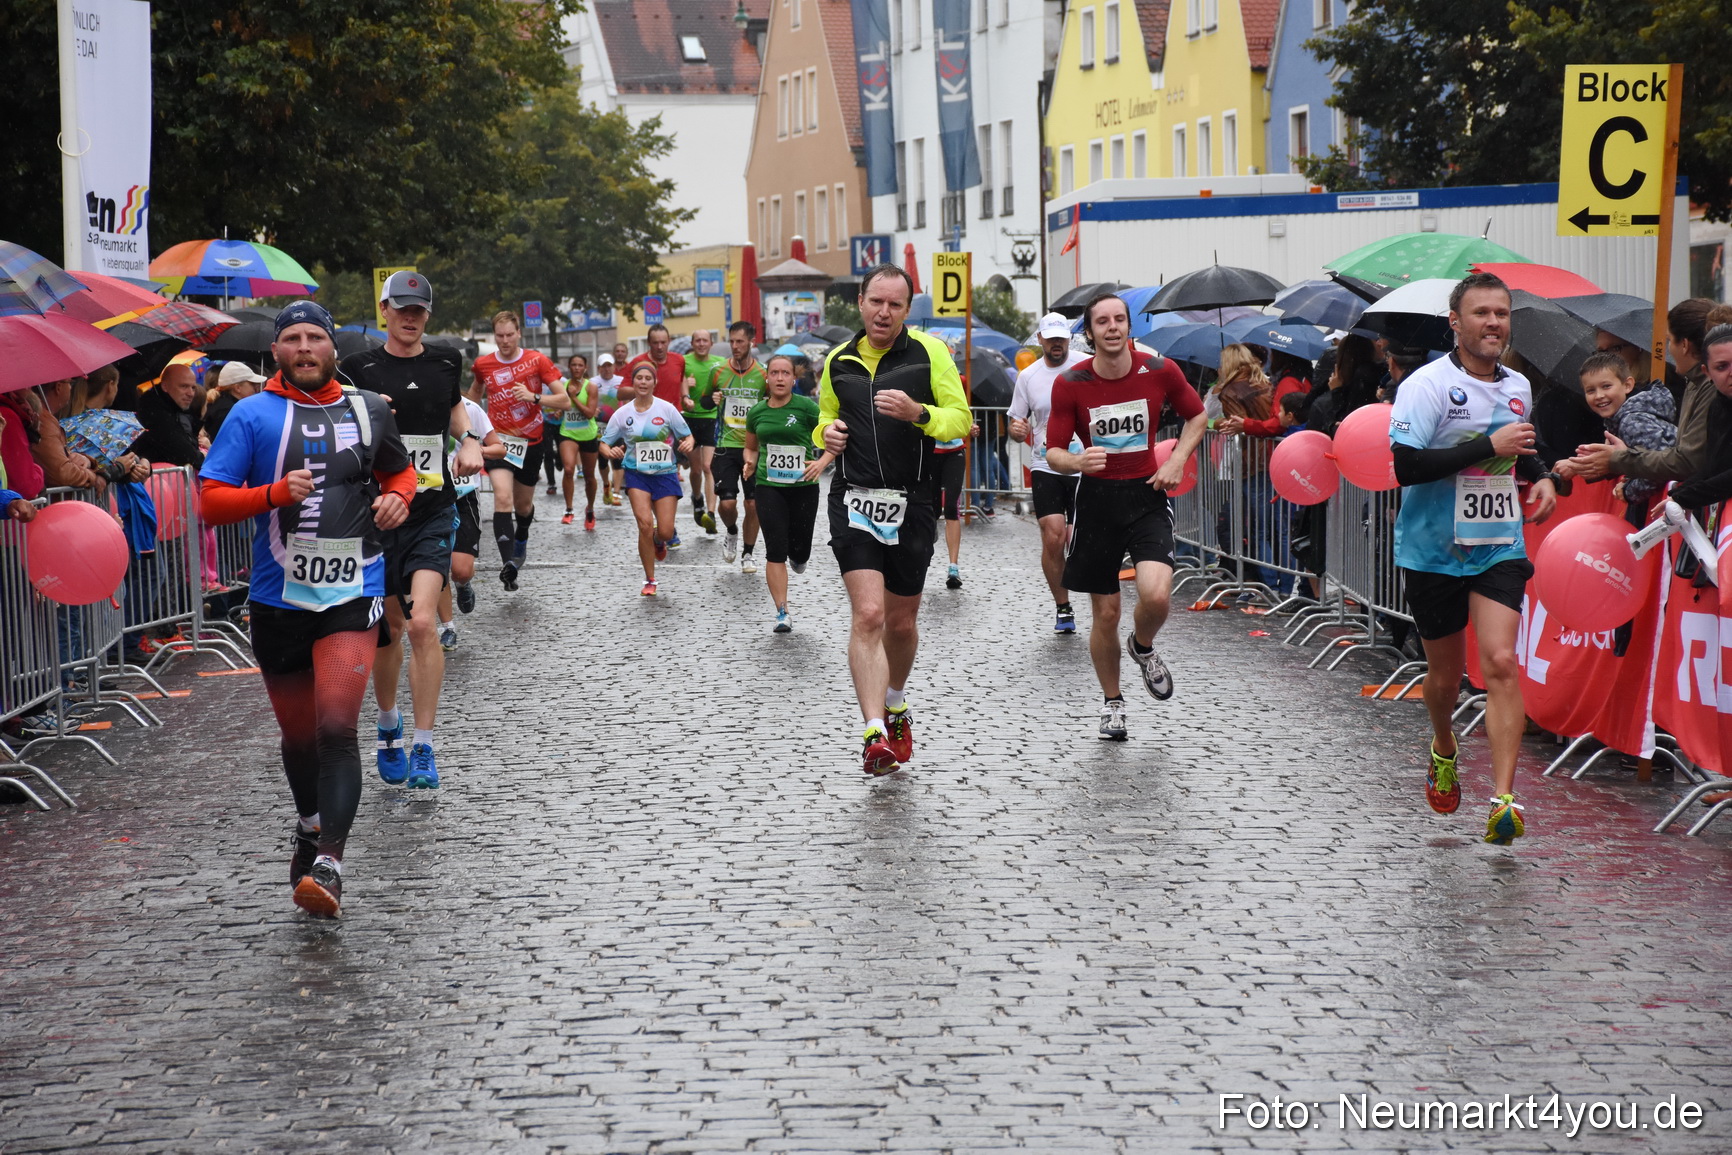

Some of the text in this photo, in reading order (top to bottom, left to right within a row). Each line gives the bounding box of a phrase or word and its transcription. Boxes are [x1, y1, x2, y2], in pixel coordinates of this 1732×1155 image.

[861, 40, 888, 111] K&L
[1578, 72, 1668, 102] Block
[1096, 98, 1122, 129] HOTEL
[1588, 116, 1649, 200] C
[937, 255, 967, 267] Block
[943, 272, 962, 302] D
[526, 318, 541, 326] TAXI
[646, 316, 662, 324] TAXI
[721, 387, 761, 399] BOCK
[1113, 402, 1143, 413] BOCK
[1096, 413, 1145, 437] 3046
[640, 449, 669, 462] 2407
[770, 454, 801, 469] 2331
[1463, 492, 1514, 519] 3031
[323, 541, 357, 551] BOCK
[292, 554, 357, 584] 3039
